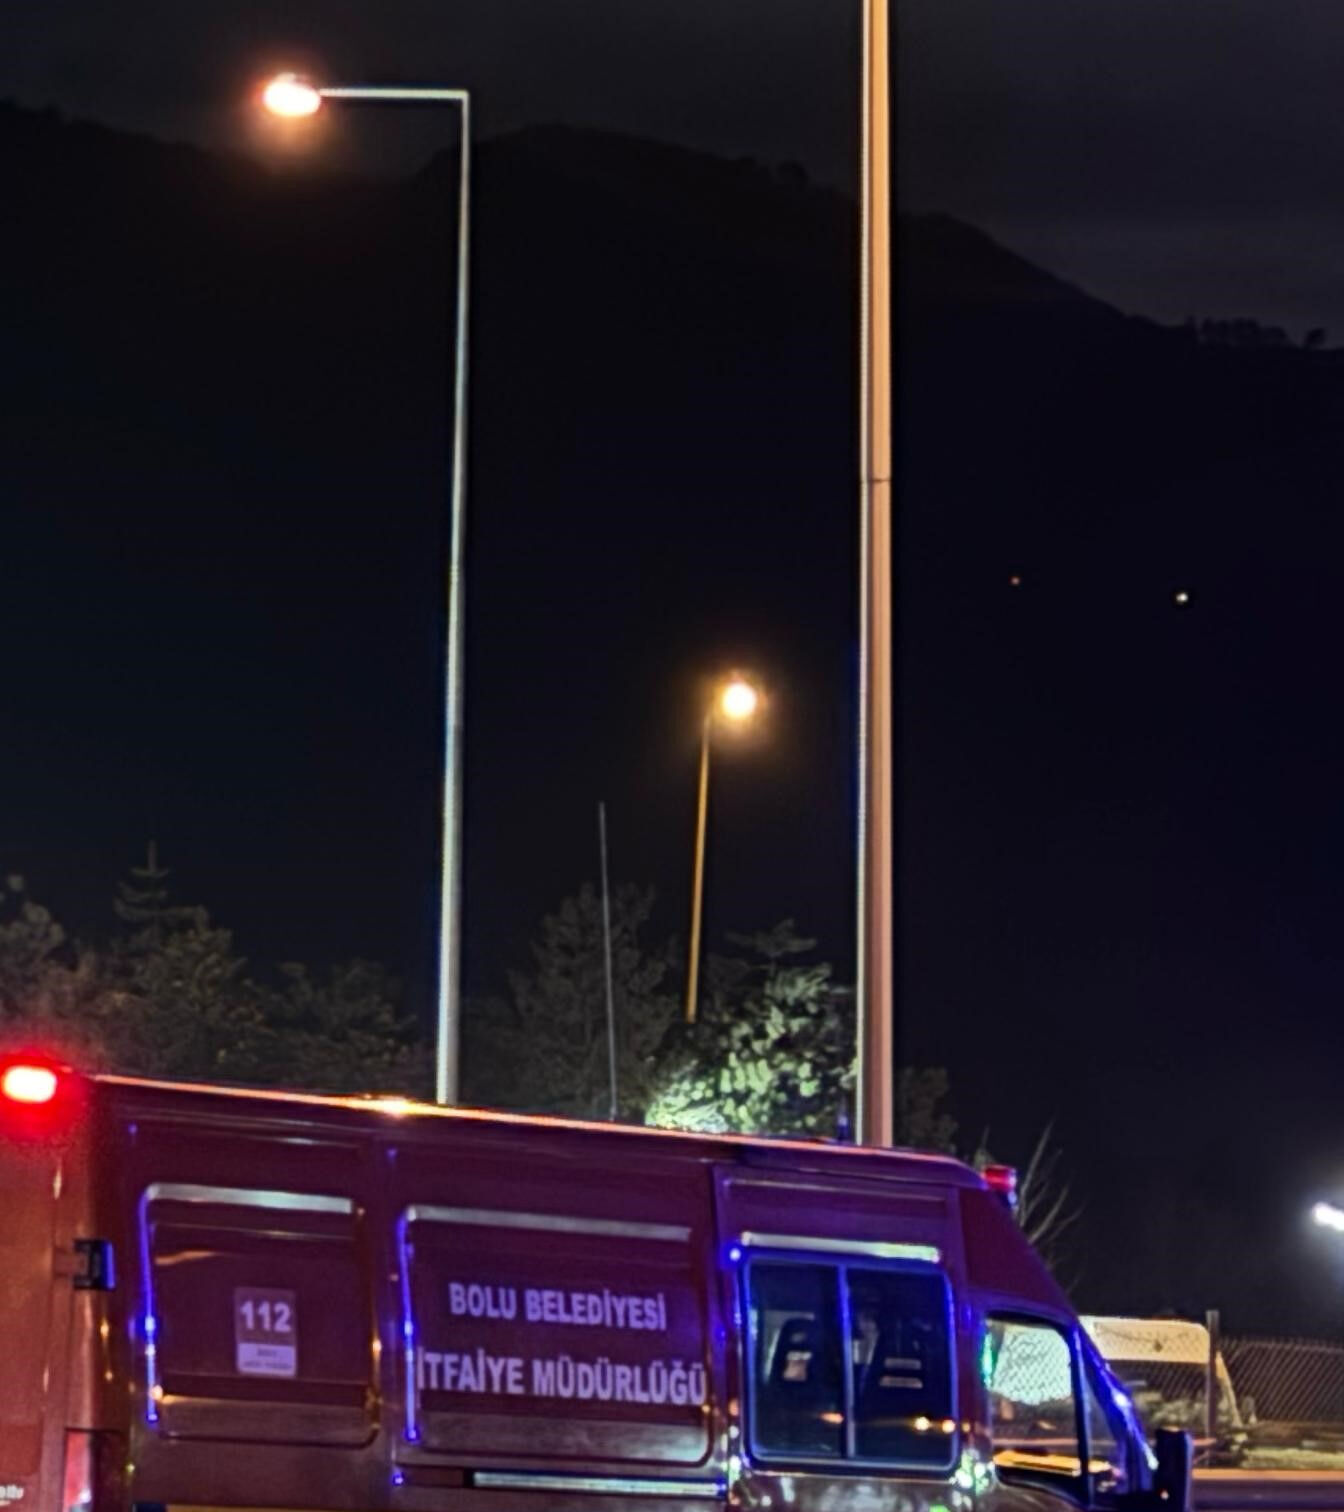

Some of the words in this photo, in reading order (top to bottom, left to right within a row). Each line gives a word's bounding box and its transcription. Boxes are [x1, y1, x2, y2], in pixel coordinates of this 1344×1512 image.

[240, 1301, 291, 1332] 112
[449, 1282, 517, 1319] BOLU
[525, 1287, 667, 1331] BELEDİYESİ
[417, 1346, 524, 1394] İTFAİYE
[532, 1354, 707, 1406] MÜDÜRLÜĞÜ
